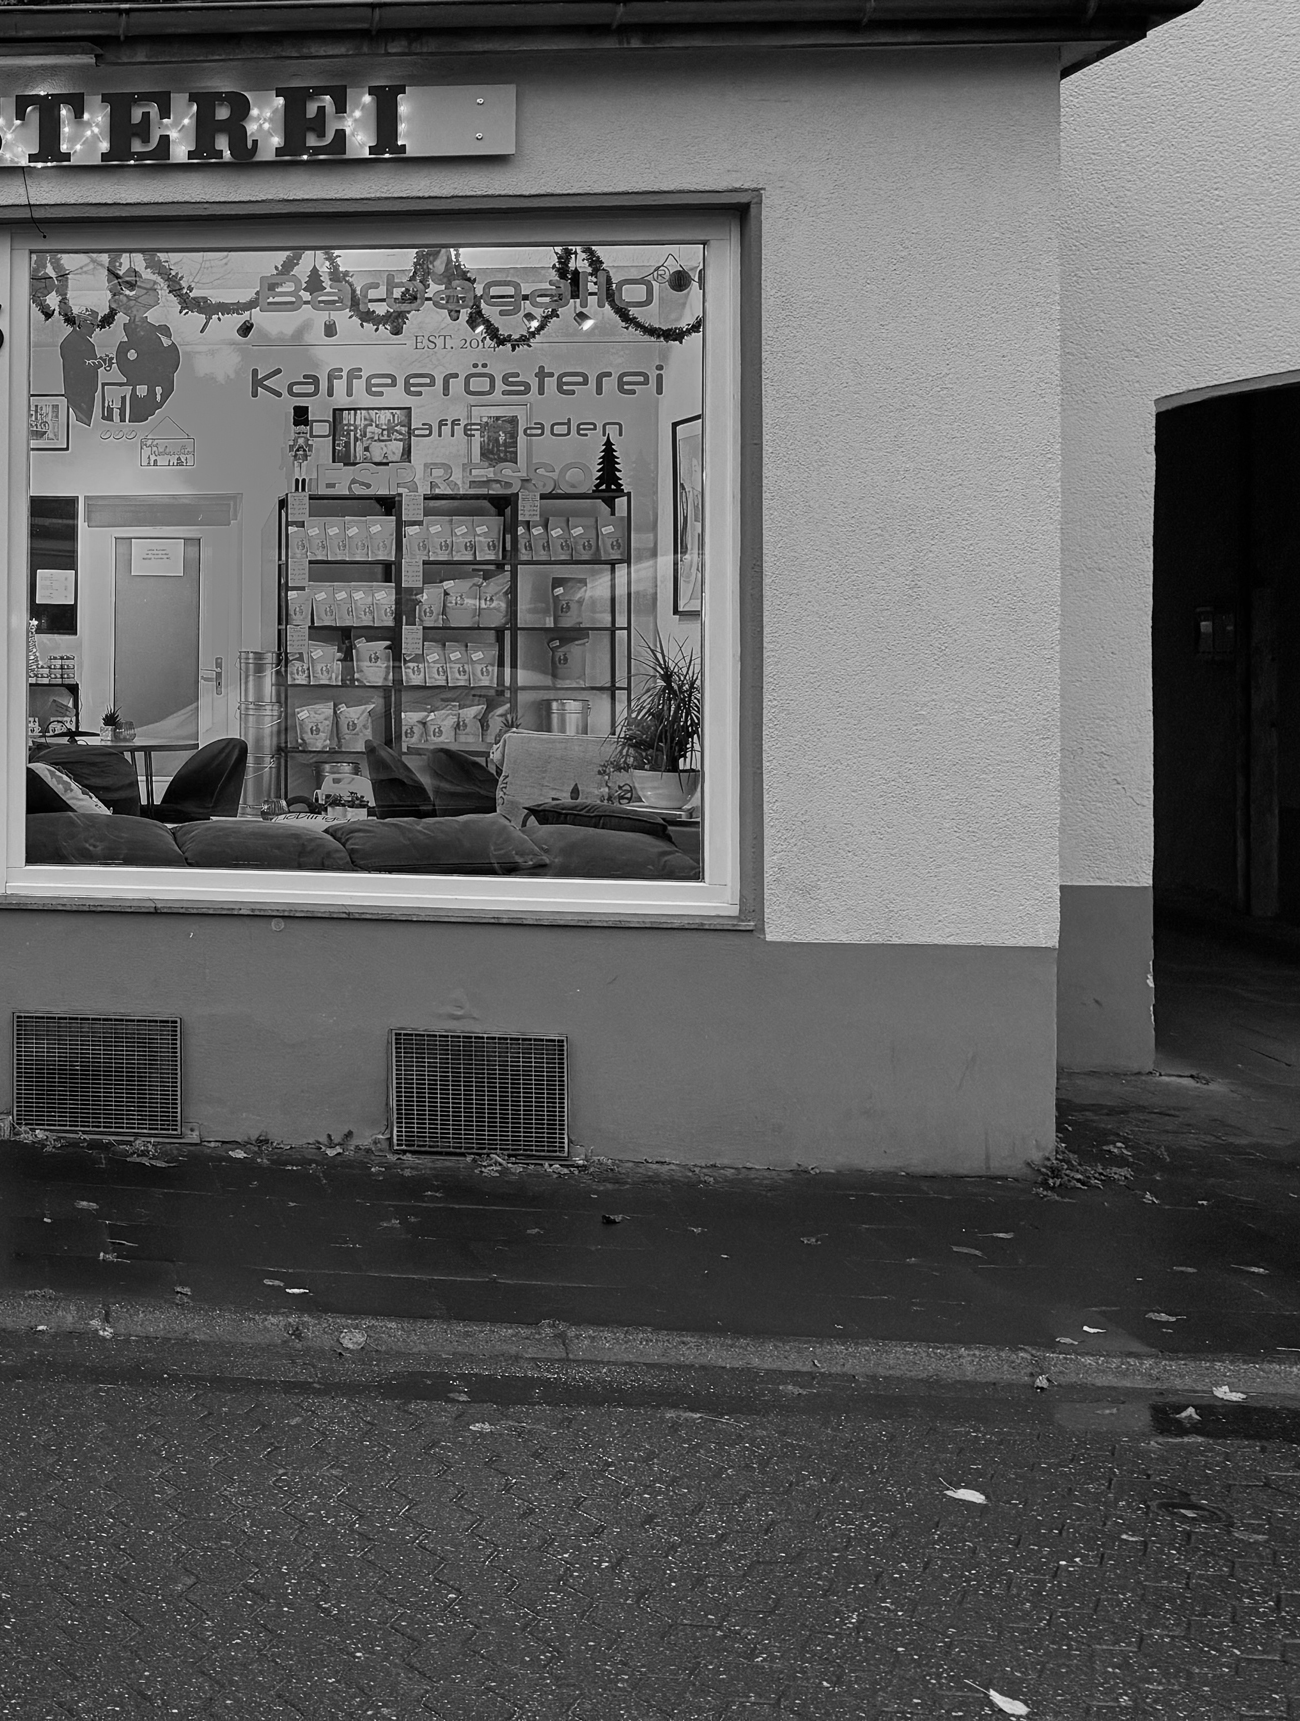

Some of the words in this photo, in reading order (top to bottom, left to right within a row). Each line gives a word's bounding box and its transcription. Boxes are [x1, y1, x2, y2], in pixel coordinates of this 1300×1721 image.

[259, 270, 654, 316] Barbagallo
[413, 334, 454, 350] EST.
[459, 337, 498, 353] 2014
[250, 362, 665, 399] Kaffeerösterei
[316, 461, 595, 495] ESPRESSO
